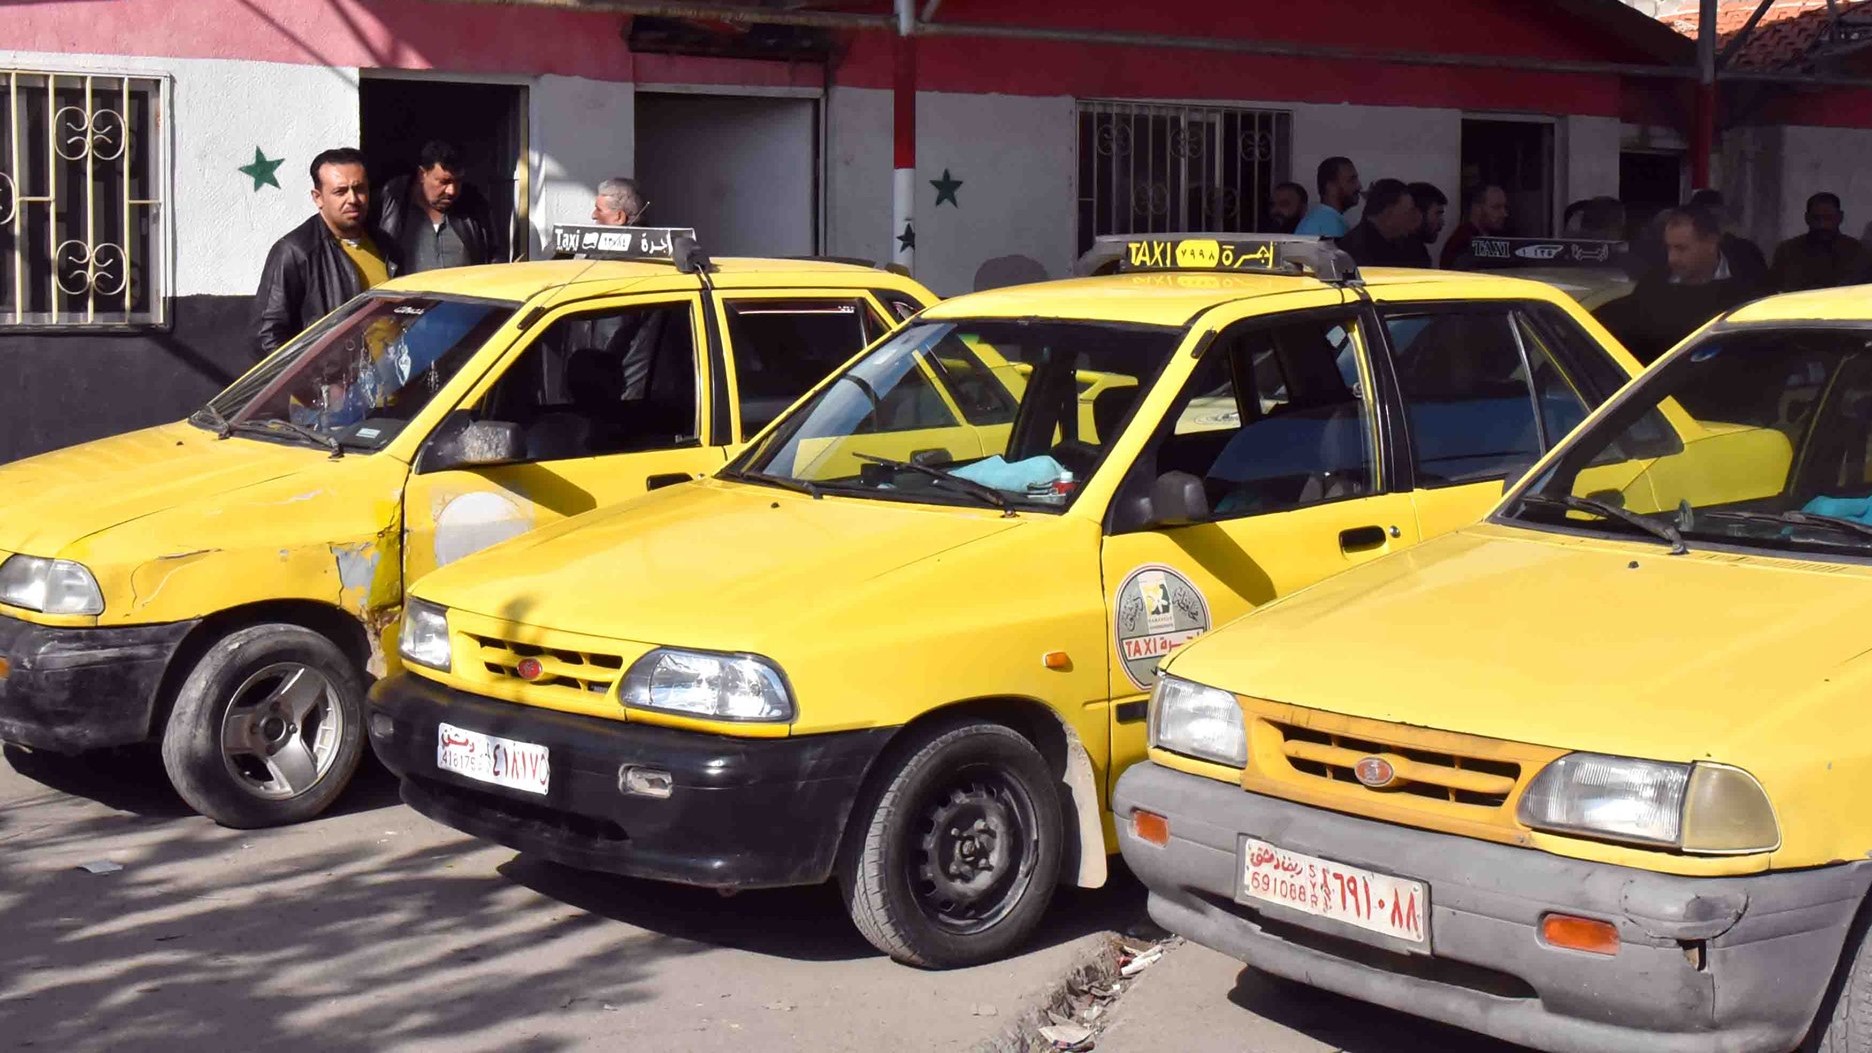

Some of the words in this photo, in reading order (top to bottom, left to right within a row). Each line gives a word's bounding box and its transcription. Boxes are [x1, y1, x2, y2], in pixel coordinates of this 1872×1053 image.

[555, 229, 580, 251] Taxi
[1472, 240, 1511, 258] TAXI
[1128, 240, 1171, 267] TAXI
[1181, 249, 1215, 260] ٧٩٩٨
[1125, 638, 1158, 657] TAXI
[493, 744, 550, 786] ٤١٨١٧٥
[1251, 871, 1306, 902] 691088
[1333, 871, 1419, 933] ٦٩١٠٨٨
